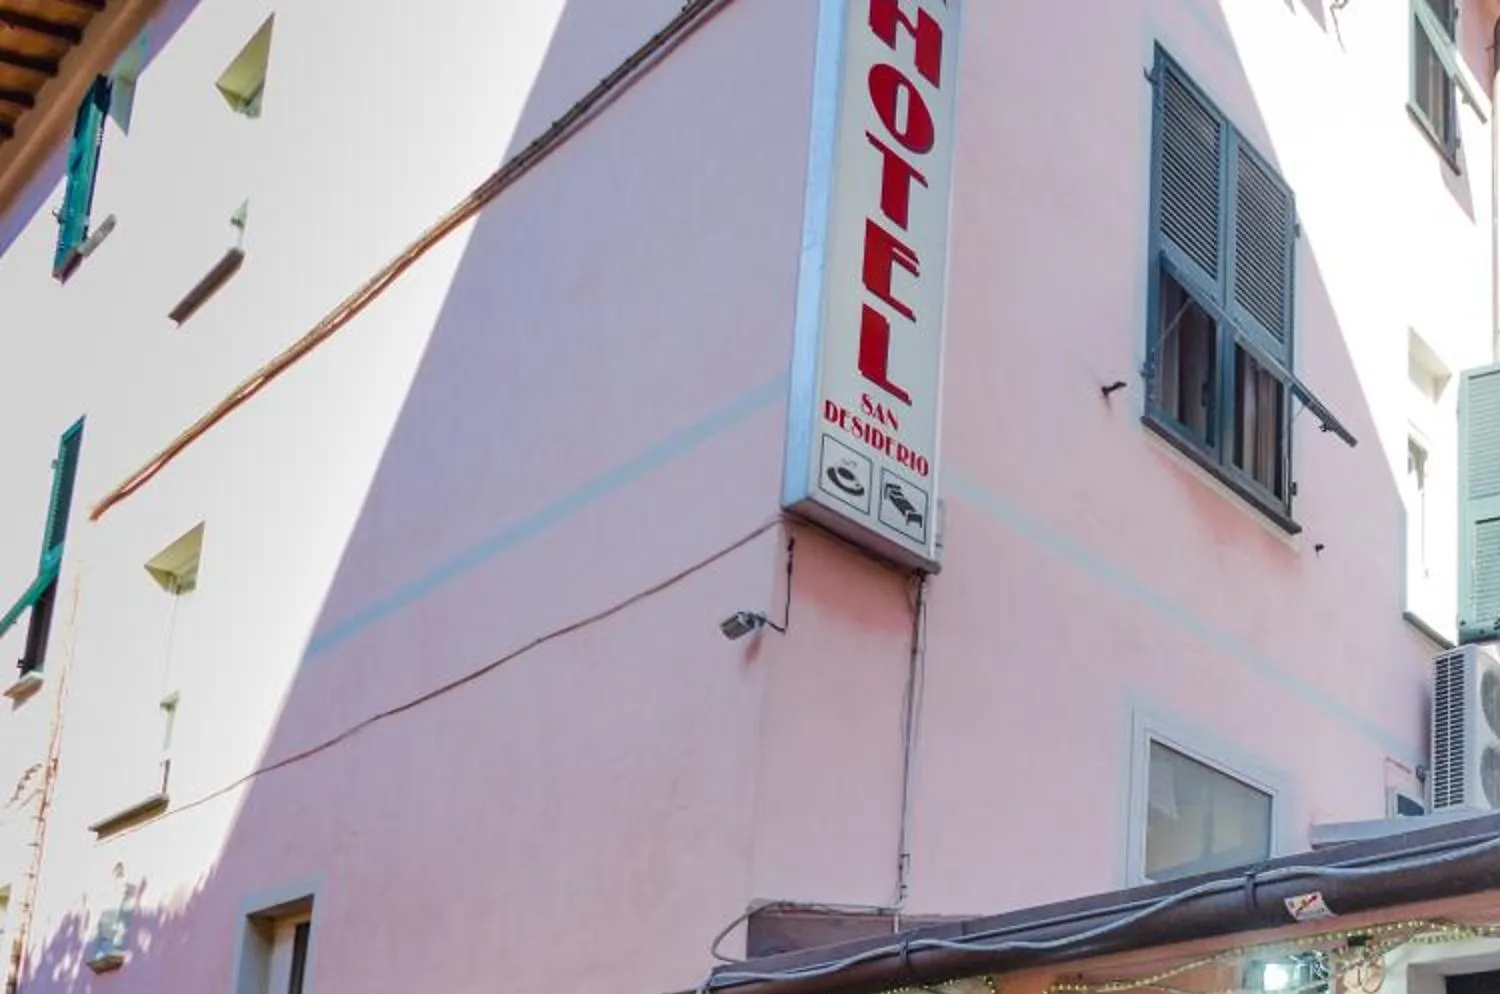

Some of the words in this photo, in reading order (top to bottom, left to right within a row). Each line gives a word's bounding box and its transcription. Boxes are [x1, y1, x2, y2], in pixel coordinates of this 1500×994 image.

[858, 0, 943, 406] HOTEL
[824, 399, 929, 477] DESIDERIO
[860, 393, 898, 431] SAN
